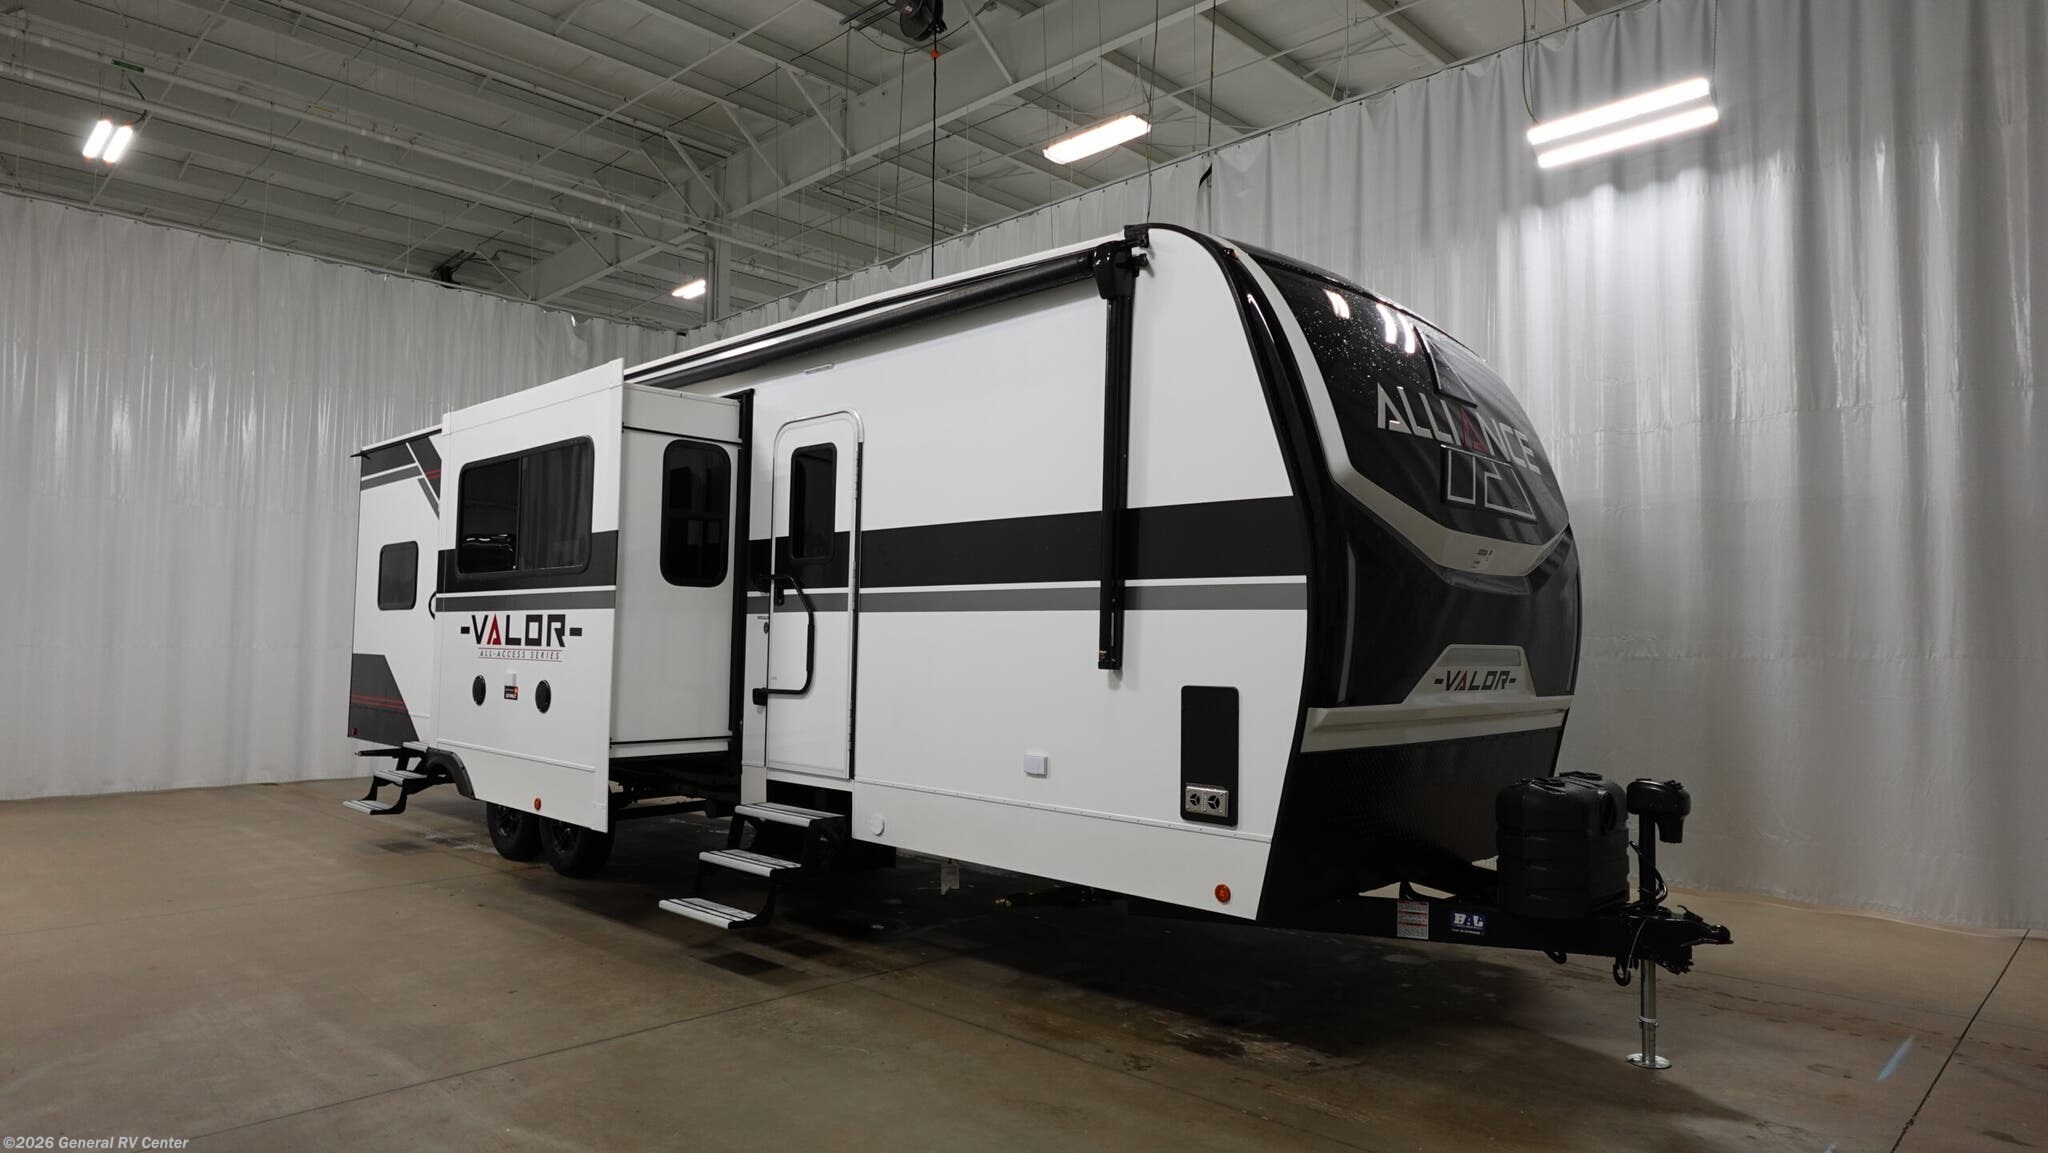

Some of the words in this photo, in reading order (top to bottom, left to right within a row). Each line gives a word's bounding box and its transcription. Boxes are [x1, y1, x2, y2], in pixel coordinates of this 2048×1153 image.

[1377, 382, 1542, 475] ALLIANCE
[480, 650, 526, 659] ALL-ACCESS
[530, 651, 560, 660] SERIES
